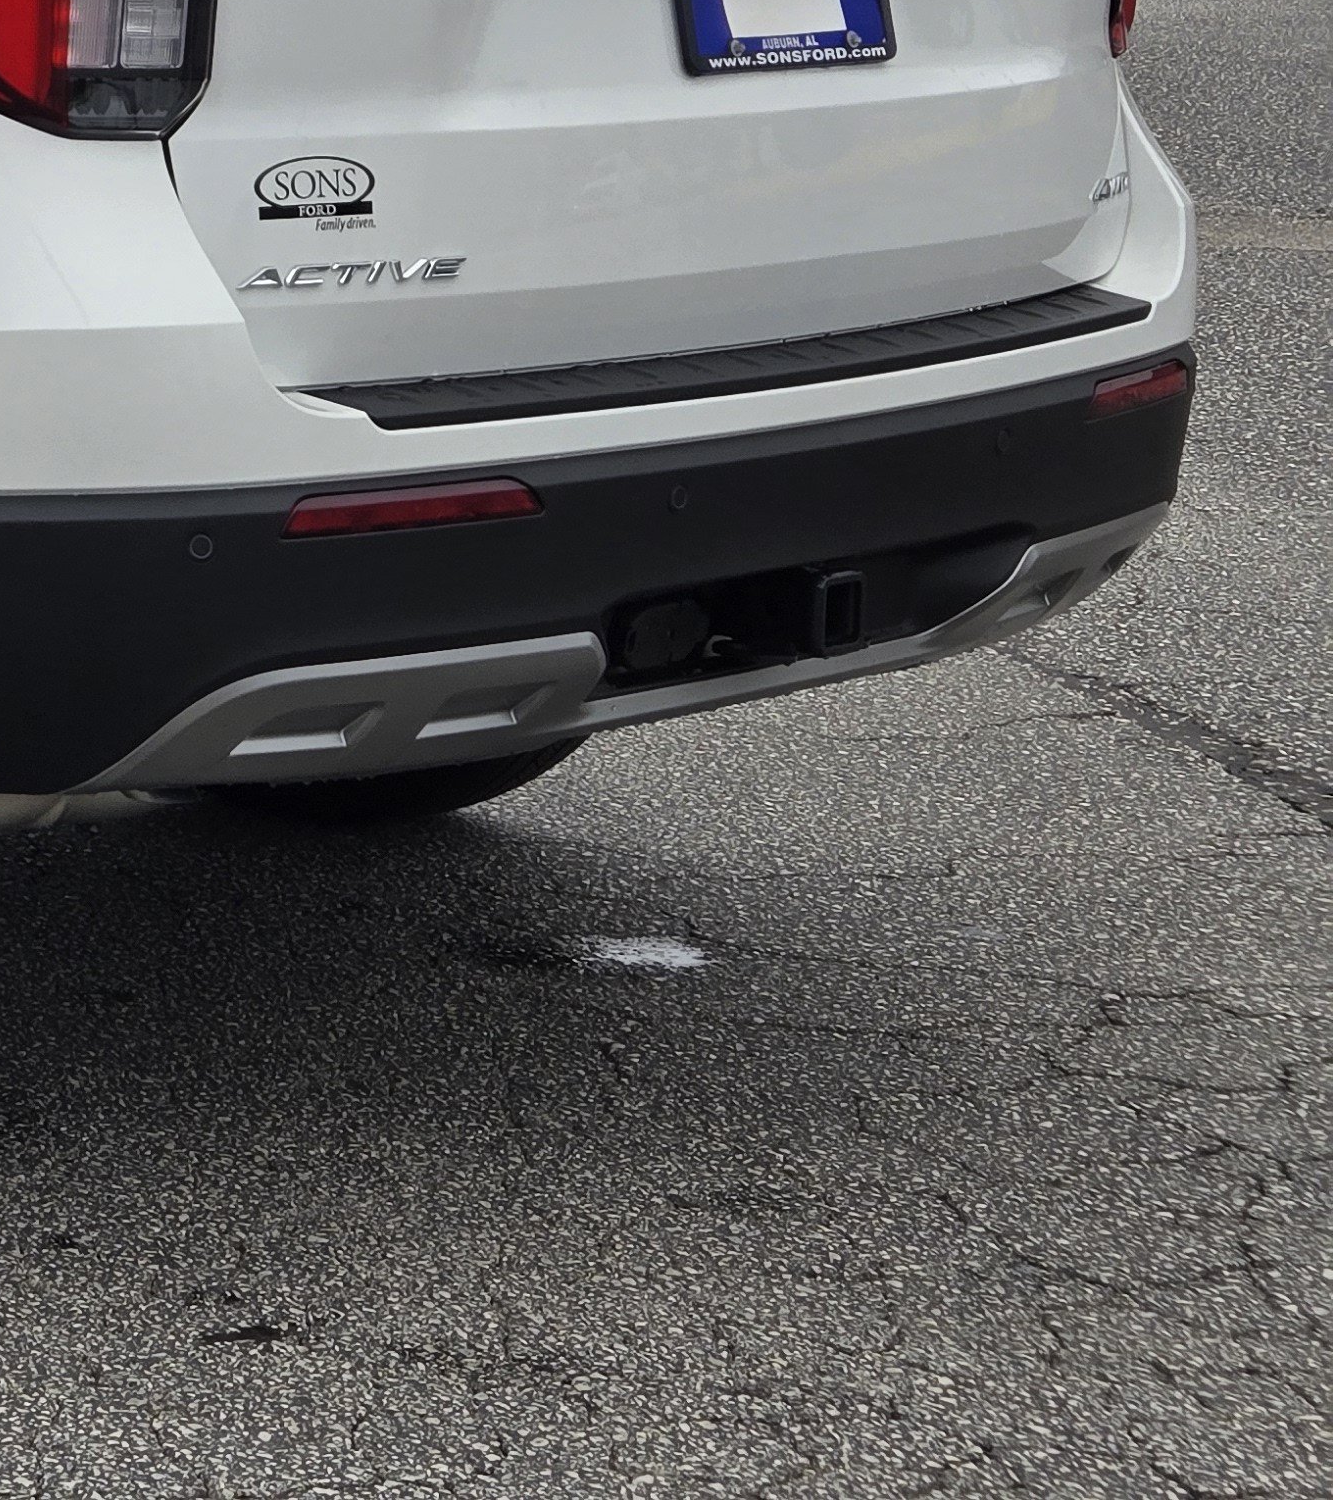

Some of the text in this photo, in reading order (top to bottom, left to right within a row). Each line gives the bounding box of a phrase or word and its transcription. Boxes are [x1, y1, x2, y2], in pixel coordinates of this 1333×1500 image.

[762, 35, 819, 49] AUBURN, AL
[708, 46, 887, 68] www.SONSFORD.com
[273, 168, 357, 201] SONS
[298, 204, 337, 217] FORD
[315, 218, 346, 233] Family
[235, 255, 467, 290] ACTIVE
